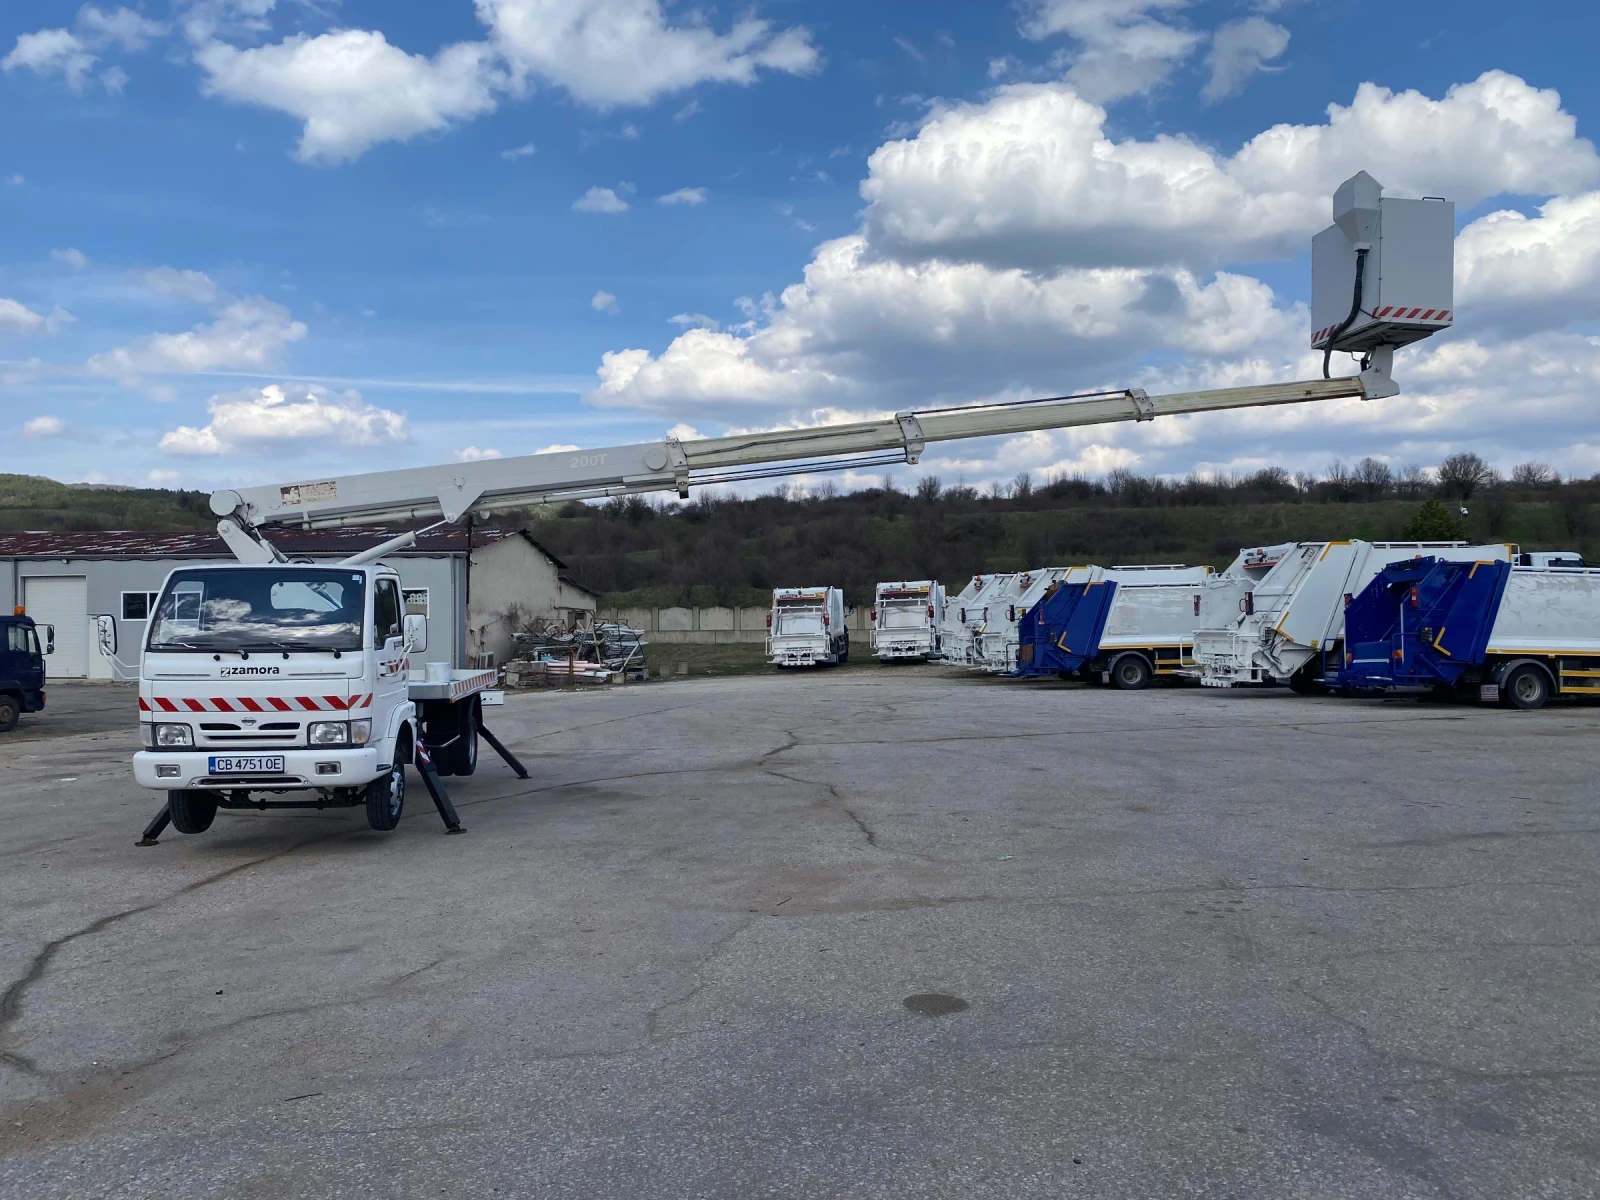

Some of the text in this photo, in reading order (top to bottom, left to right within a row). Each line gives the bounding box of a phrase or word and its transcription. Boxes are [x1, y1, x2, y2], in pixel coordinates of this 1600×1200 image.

[570, 453, 608, 468] 200T
[231, 666, 280, 675] zamora
[217, 758, 233, 770] CB
[235, 758, 262, 770] 4751
